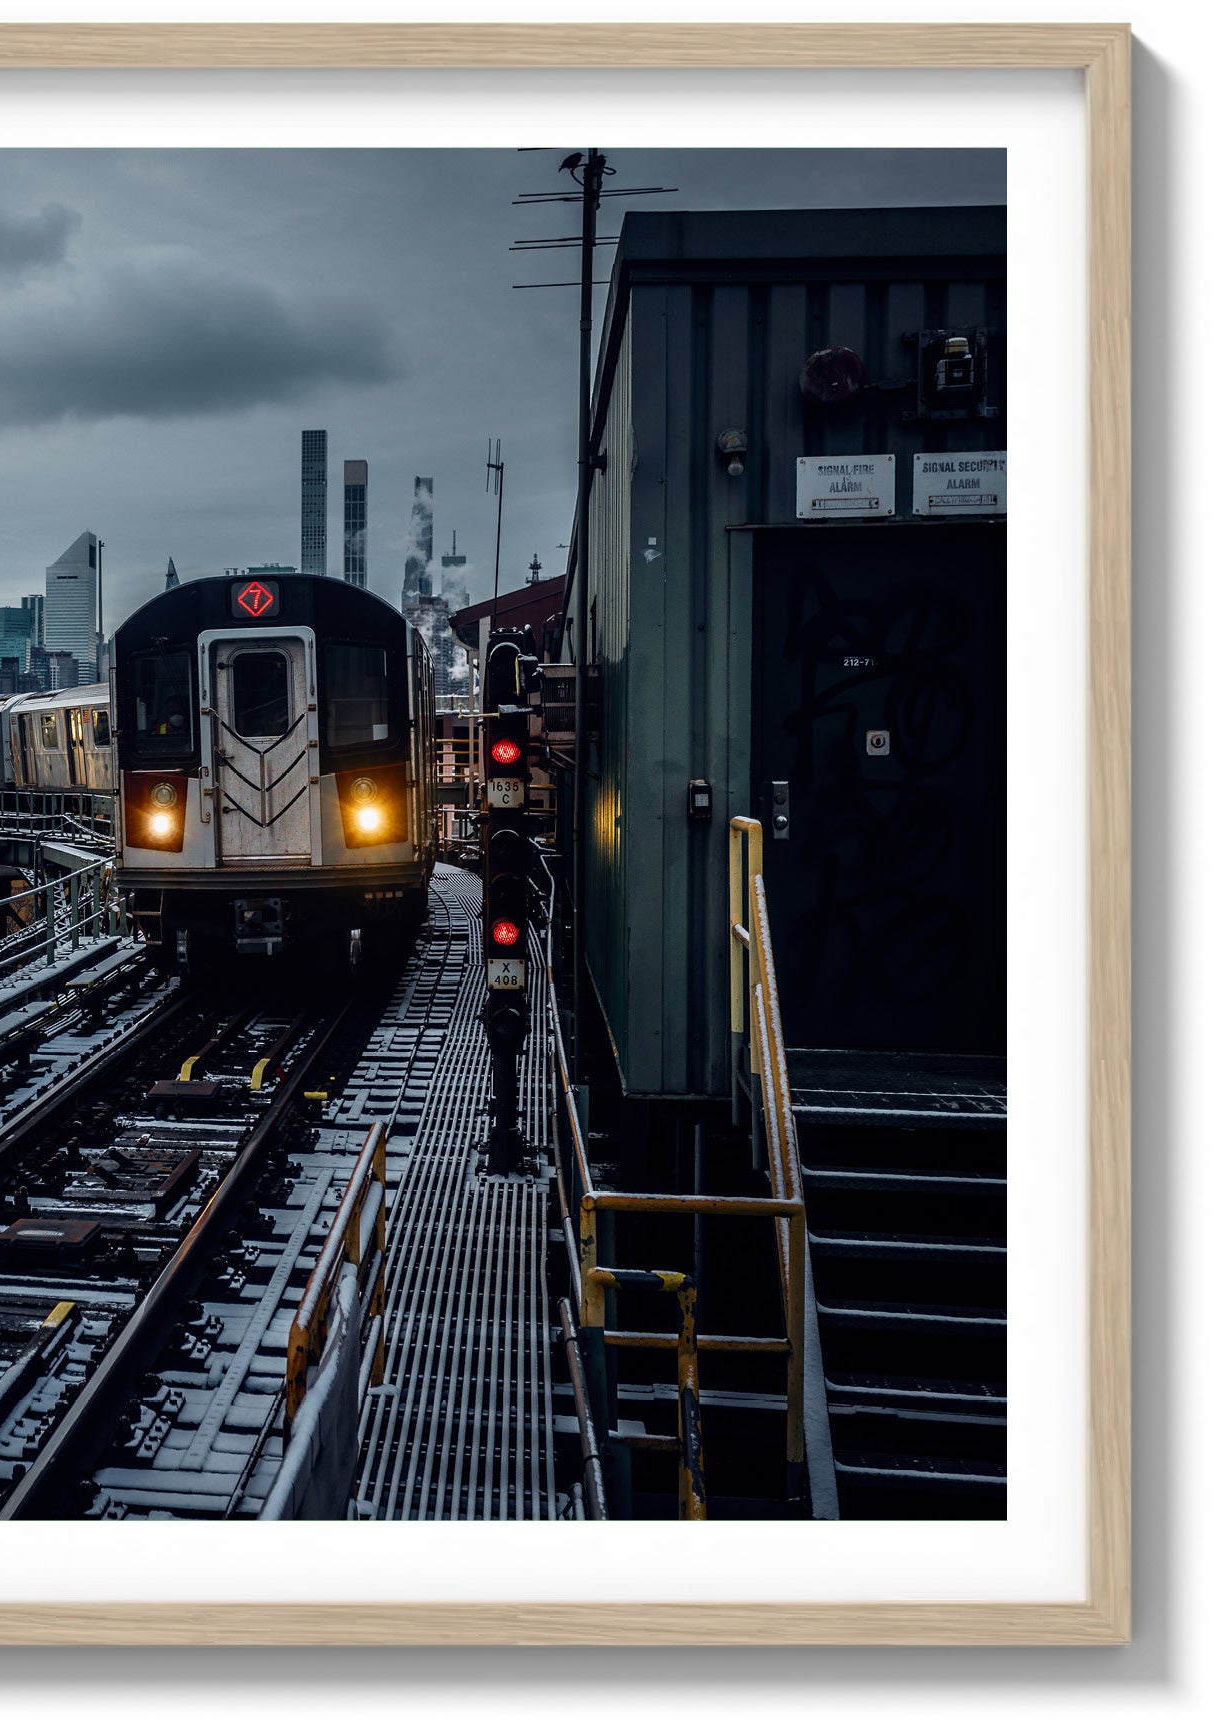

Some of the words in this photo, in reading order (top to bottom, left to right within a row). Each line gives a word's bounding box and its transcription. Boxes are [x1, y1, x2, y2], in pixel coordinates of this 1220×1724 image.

[817, 465, 851, 477] SIGNAL
[853, 464, 875, 475] FIRE
[922, 461, 956, 473] SIGNAL
[829, 481, 863, 493] ALARM
[946, 478, 981, 490] ALARM
[249, 589, 261, 610] 7
[492, 781, 519, 792] 1635
[502, 793, 510, 805] C
[502, 962, 510, 973] X
[494, 975, 518, 986] 408
